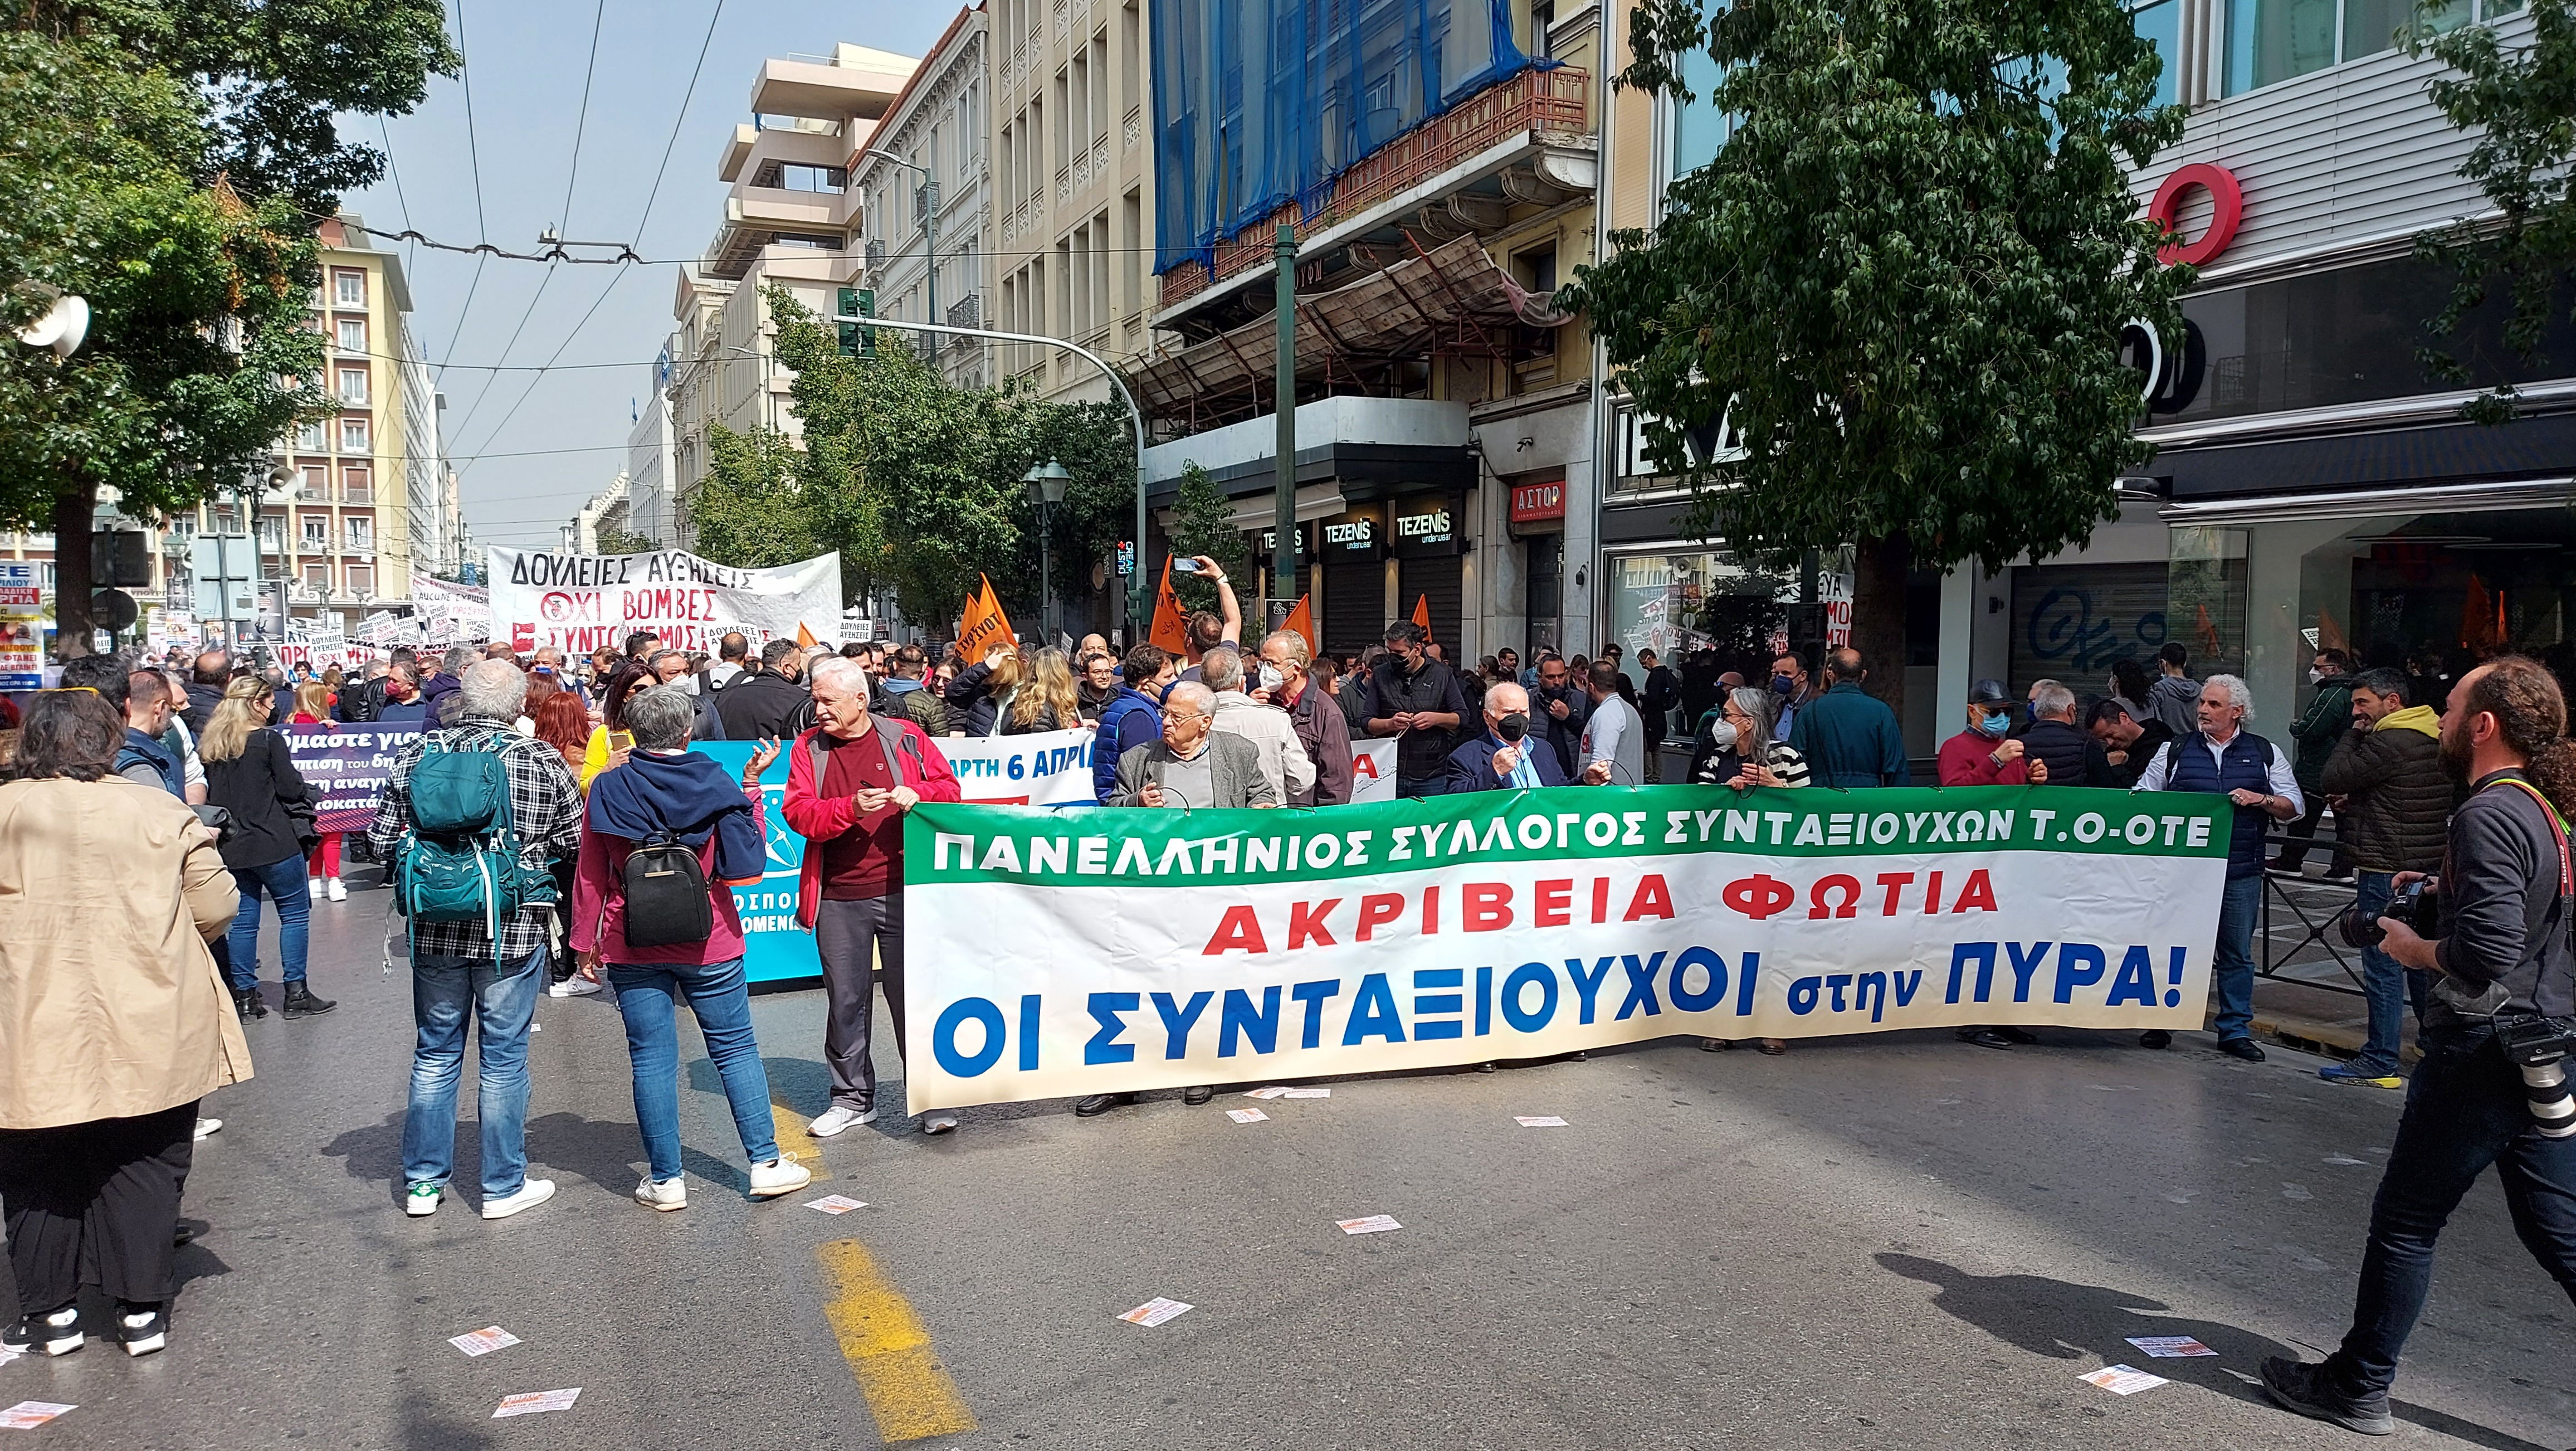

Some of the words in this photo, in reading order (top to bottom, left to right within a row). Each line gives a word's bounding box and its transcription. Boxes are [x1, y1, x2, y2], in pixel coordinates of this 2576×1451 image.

[1518, 485, 1560, 511] ΑΣΤΟΡ
[1325, 517, 1370, 544] TEZENIS
[1397, 508, 1450, 537] TEZENIS
[1346, 540, 1372, 550] underwear
[1422, 533, 1452, 544] underwear
[1125, 541, 1134, 574] CREAM
[510, 552, 631, 587] ΔΟΥΛΕΙΕΣ
[648, 553, 755, 590] ΑΥΞΗΣΕΙΣ
[623, 589, 717, 622] ΒΟΜΒΕΣ
[311, 634, 343, 645] ΔΟΥΛΕΙΕΣ
[840, 622, 870, 631] ΔΟΥΛΕΙΕΣ
[840, 631, 869, 640] ΑΥΞΗΣΕΙΣ
[313, 642, 344, 653] ΑΥΞΗΣΕΙΣ
[281, 729, 372, 753] όμαστε
[377, 731, 425, 751] για
[345, 759, 369, 769] του
[1007, 754, 1024, 780] 6
[934, 830, 1373, 875] ΠΑΝΕΛΛΗΝΙΟΣ
[1388, 811, 1647, 861] ΣΥΛΛΟΓΟΣ
[1664, 809, 2016, 846] ΣΥΝΤΑΞΙΟΥΧΩΝ
[2030, 809, 2212, 848] Τ.Ο-ΟΤΕ
[1202, 874, 1675, 956] ΑΚΡΙΒΕΙΑ
[1722, 869, 1998, 921] ΦΩΤΙΑ
[933, 994, 1042, 1078] ΟΙ
[1084, 946, 1760, 1066] ΣΥΝΤΑΞΙΟΥΧΟΙ
[1787, 970, 1923, 1023] στην
[1944, 941, 2188, 1009] ΠΥΡΑ!
